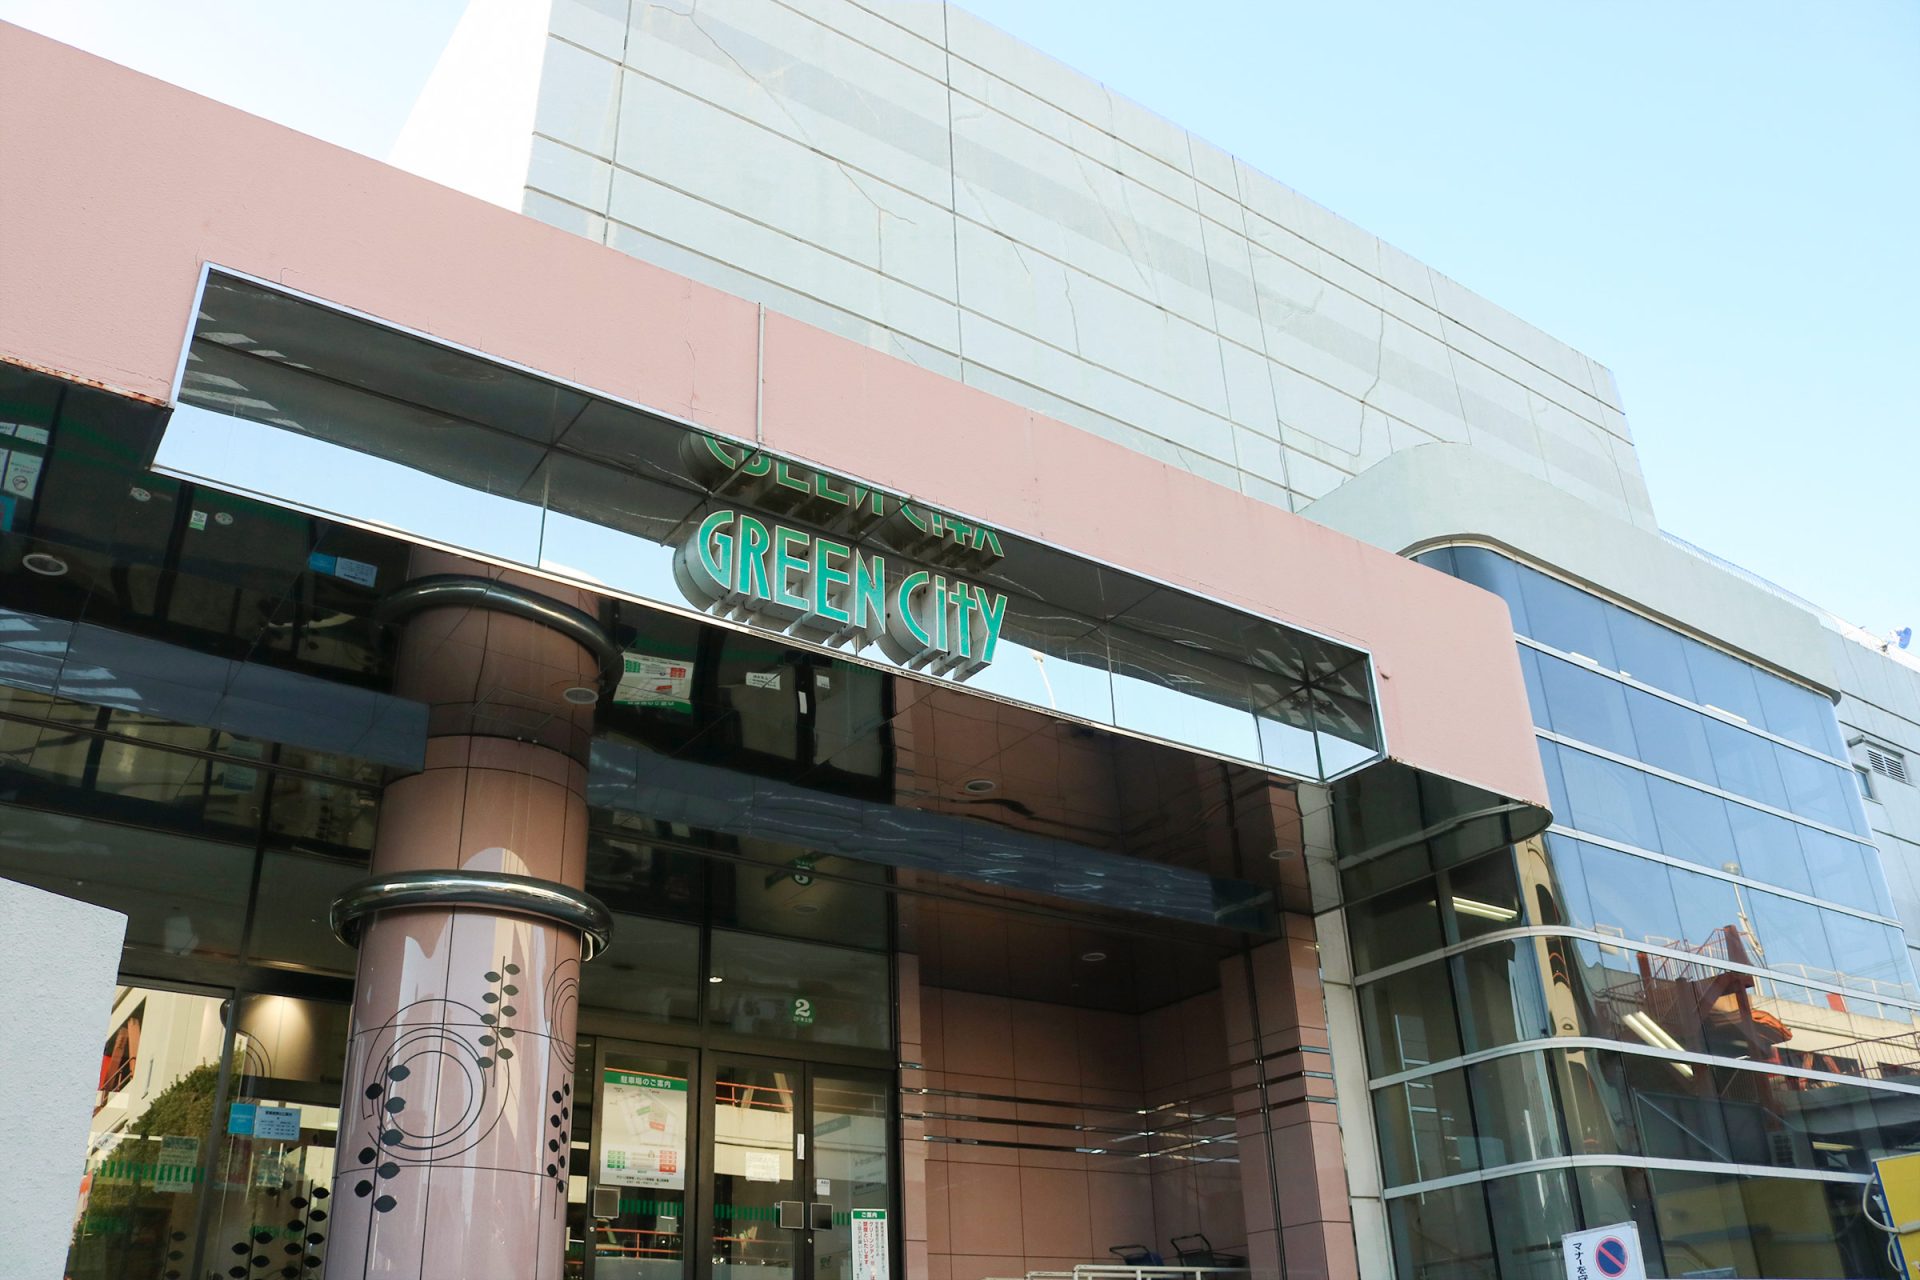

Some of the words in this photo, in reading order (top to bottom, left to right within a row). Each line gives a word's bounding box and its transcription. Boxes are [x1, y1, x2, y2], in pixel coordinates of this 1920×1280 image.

[698, 510, 886, 634] GREEN
[898, 571, 1008, 663] City
[795, 998, 811, 1017] 2
